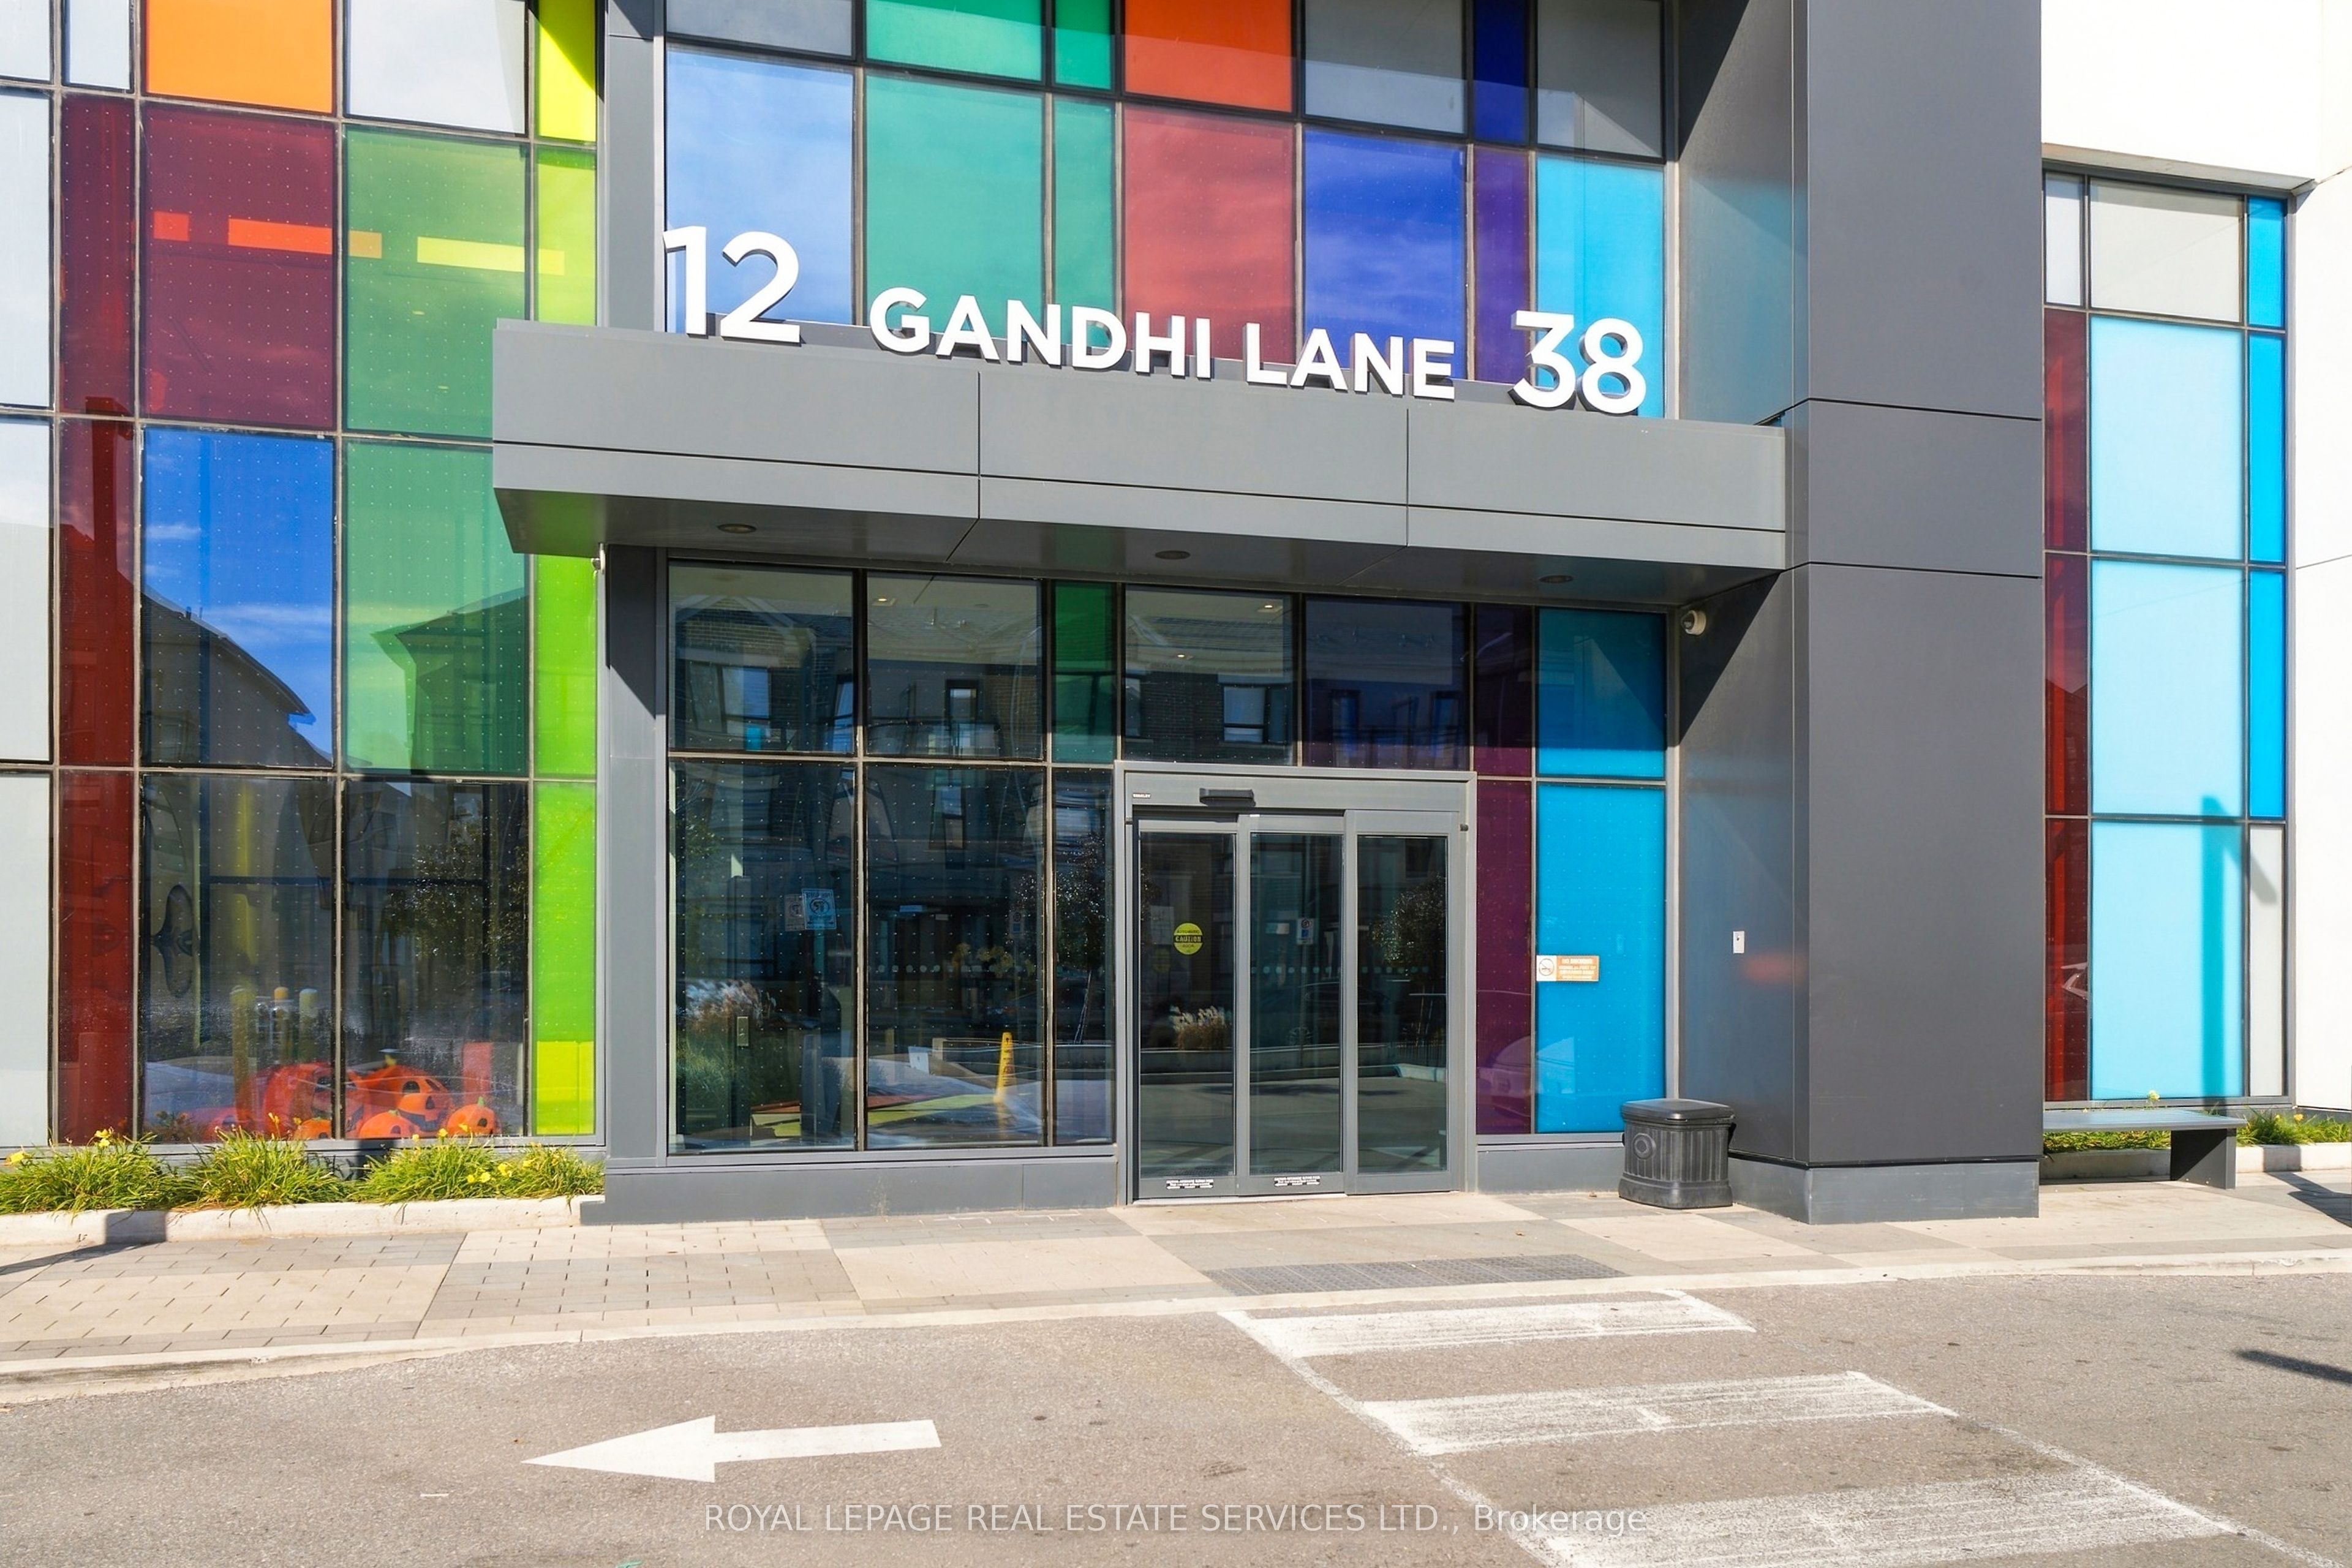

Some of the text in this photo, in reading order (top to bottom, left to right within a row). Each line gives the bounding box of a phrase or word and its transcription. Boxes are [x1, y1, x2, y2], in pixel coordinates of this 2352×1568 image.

[663, 225, 1646, 415] 12 GANDHI LANE 38
